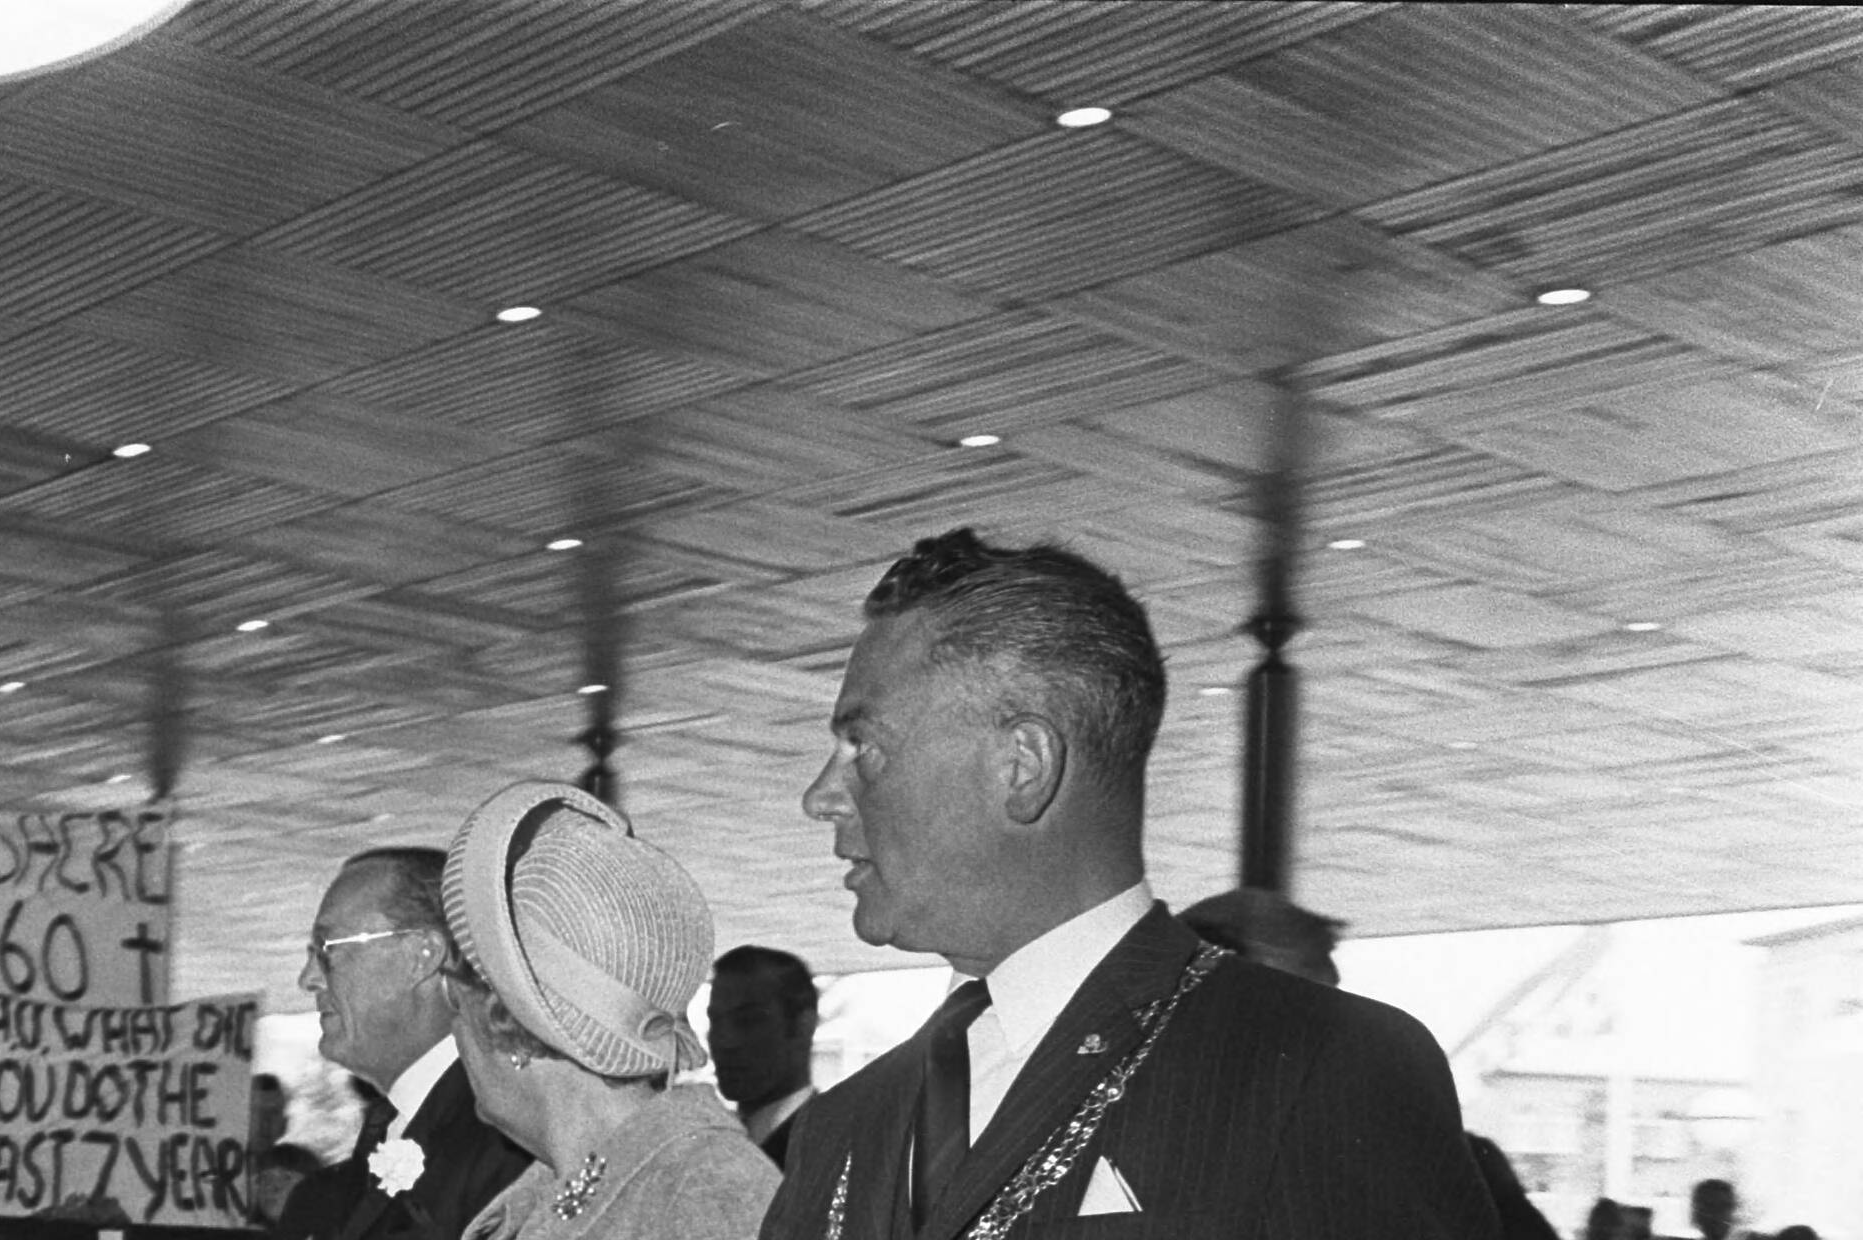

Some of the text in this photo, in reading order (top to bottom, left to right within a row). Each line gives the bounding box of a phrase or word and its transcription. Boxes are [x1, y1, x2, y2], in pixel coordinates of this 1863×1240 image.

[53, 1003, 186, 1055] WHAT
[62, 1058, 130, 1122] DO
[126, 1058, 218, 1128] THE
[81, 1130, 120, 1201] 7
